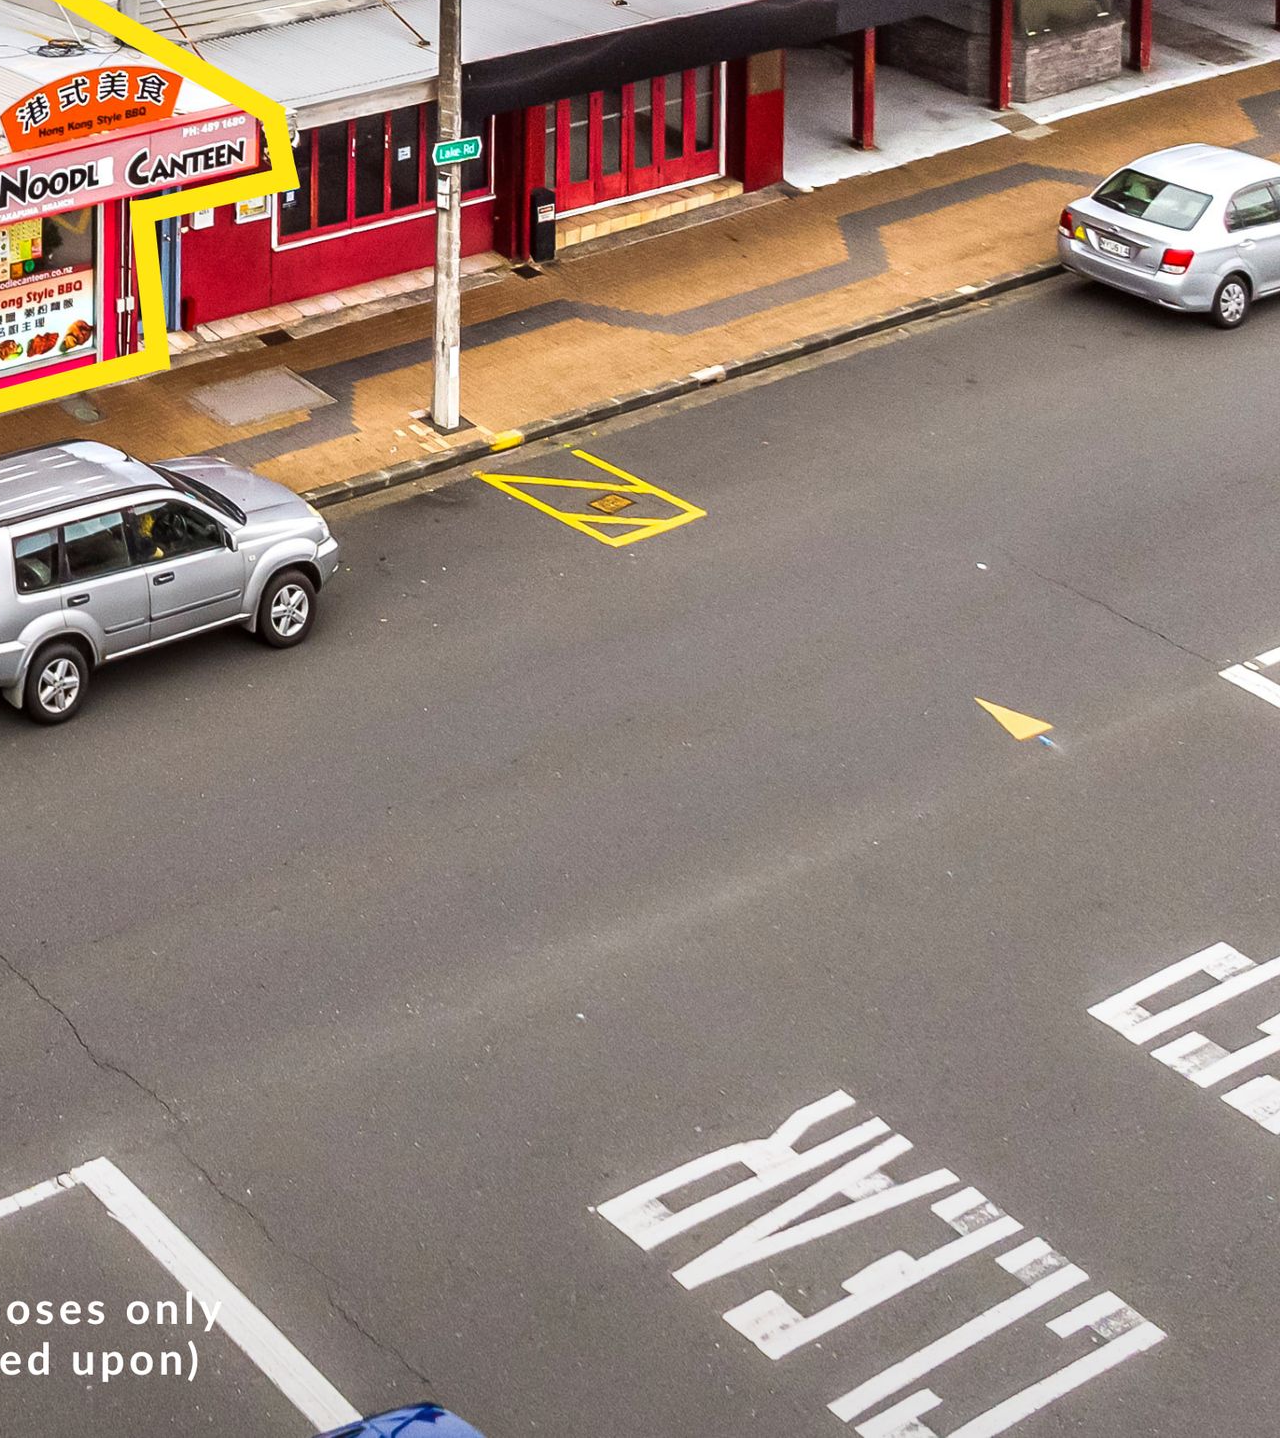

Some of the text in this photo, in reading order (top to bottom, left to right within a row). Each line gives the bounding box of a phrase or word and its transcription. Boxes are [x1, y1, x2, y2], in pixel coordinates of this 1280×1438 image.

[16, 71, 167, 133] 港式美食
[39, 106, 146, 138] Hong Kong Style BBQ
[127, 140, 245, 186] CANTEEN
[440, 143, 475, 160] Lake Rd
[26, 288, 54, 304] Style
[57, 280, 83, 296] BBQ
